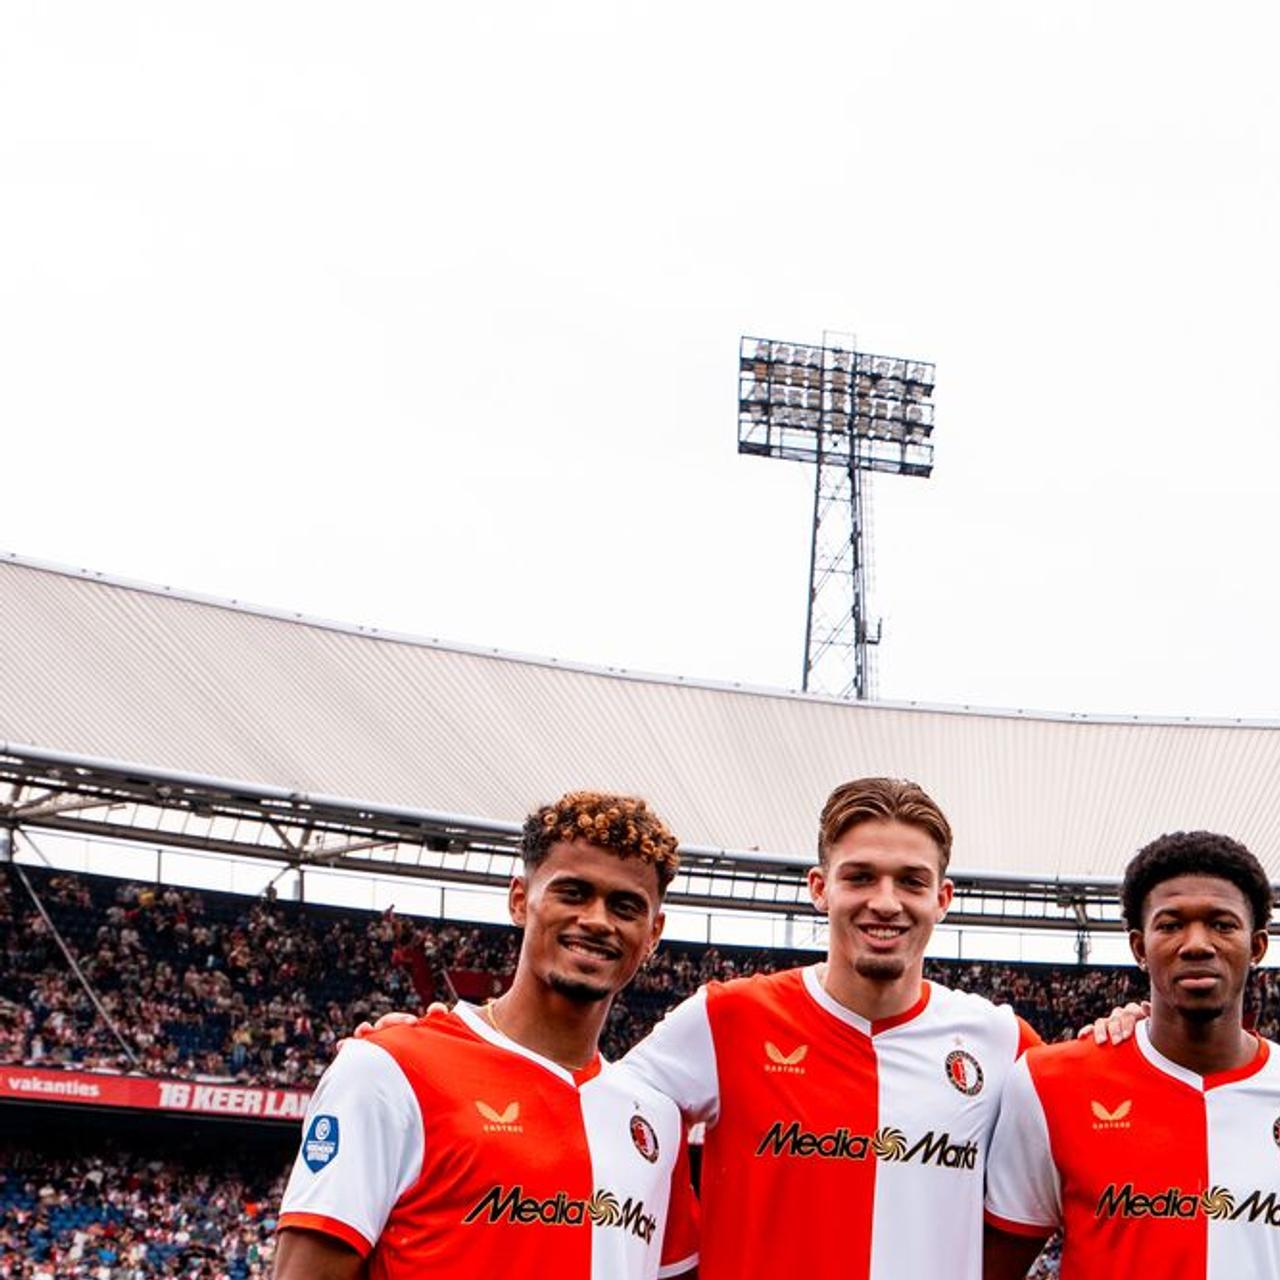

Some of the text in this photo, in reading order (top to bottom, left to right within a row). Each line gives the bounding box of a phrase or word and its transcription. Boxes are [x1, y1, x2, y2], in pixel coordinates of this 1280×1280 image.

[8, 1077, 101, 1097] vakanties
[158, 1082, 186, 1108] 16
[191, 1087, 263, 1115] KEER
[754, 1121, 979, 1171] Media Markt
[461, 1184, 586, 1226] Media
[1094, 1183, 1198, 1219] Media
